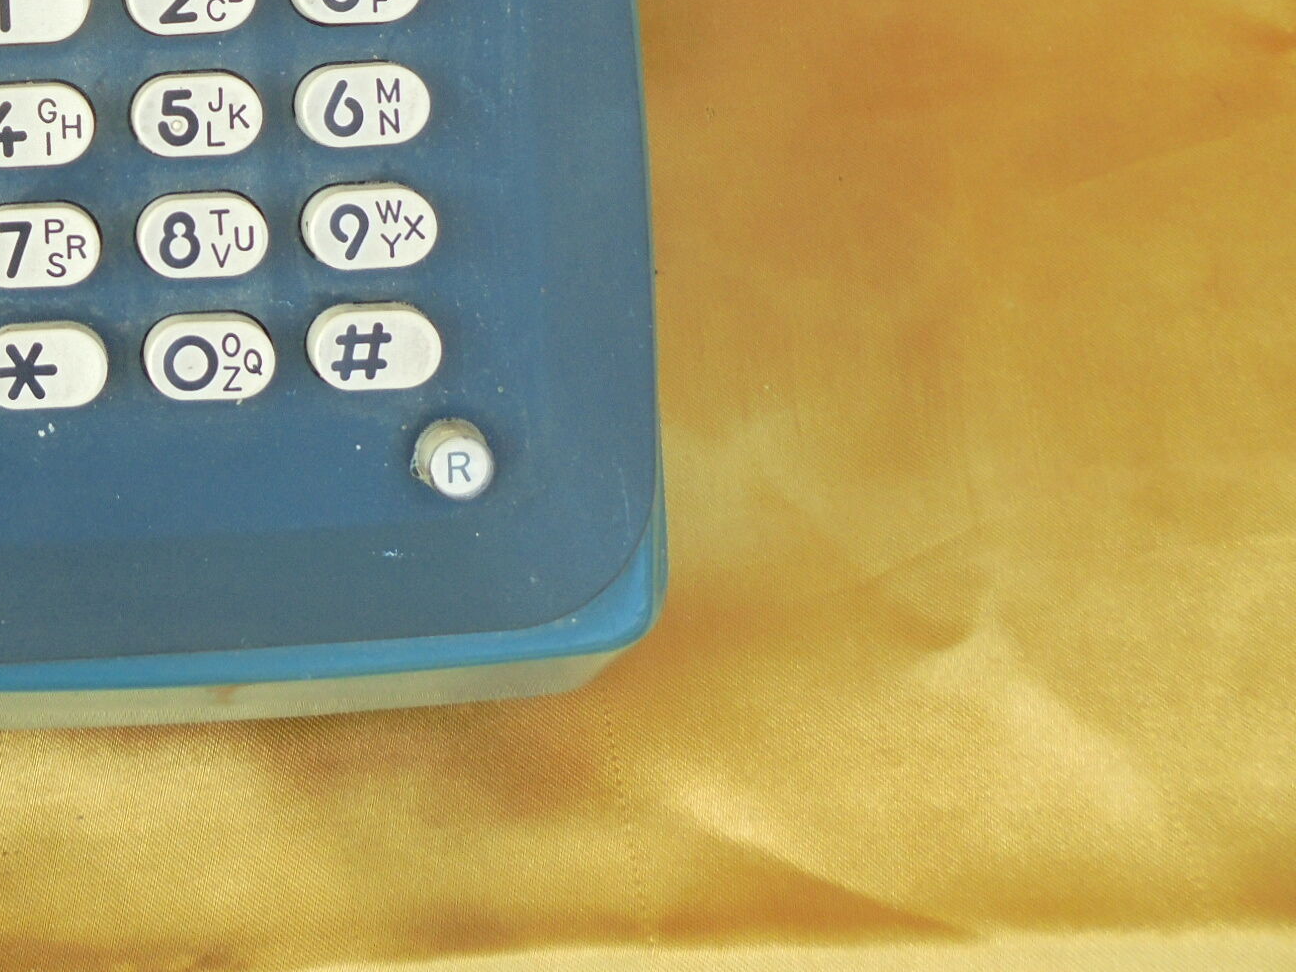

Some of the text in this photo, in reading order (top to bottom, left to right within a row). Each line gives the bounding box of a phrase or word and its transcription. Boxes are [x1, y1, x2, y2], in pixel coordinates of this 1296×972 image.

[158, 90, 199, 146] 5
[324, 80, 363, 137] 6
[160, 212, 200, 269] 8
[330, 204, 369, 260] 9
[447, 452, 471, 483] R
